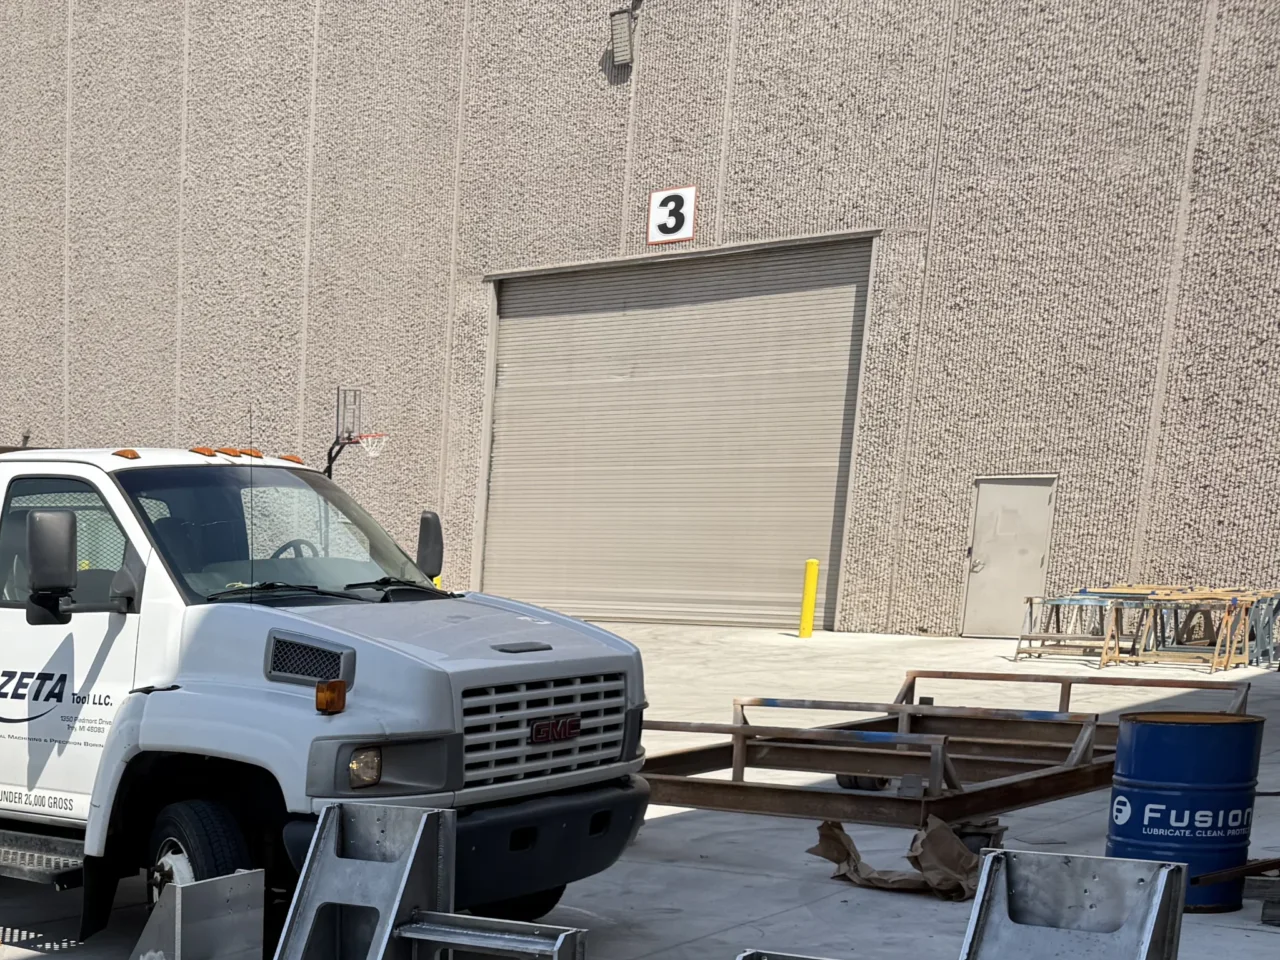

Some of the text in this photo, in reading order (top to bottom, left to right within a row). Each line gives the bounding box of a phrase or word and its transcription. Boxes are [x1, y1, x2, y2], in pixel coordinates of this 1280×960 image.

[657, 194, 685, 235] 3
[71, 692, 90, 705] Tool
[92, 694, 113, 706] LLC.
[74, 716, 98, 725] Pedmont
[532, 717, 581, 743] GMC
[48, 796, 74, 811] GROSS
[1142, 826, 1194, 837] LUBRICATE.
[1195, 828, 1226, 837] CLEAN.
